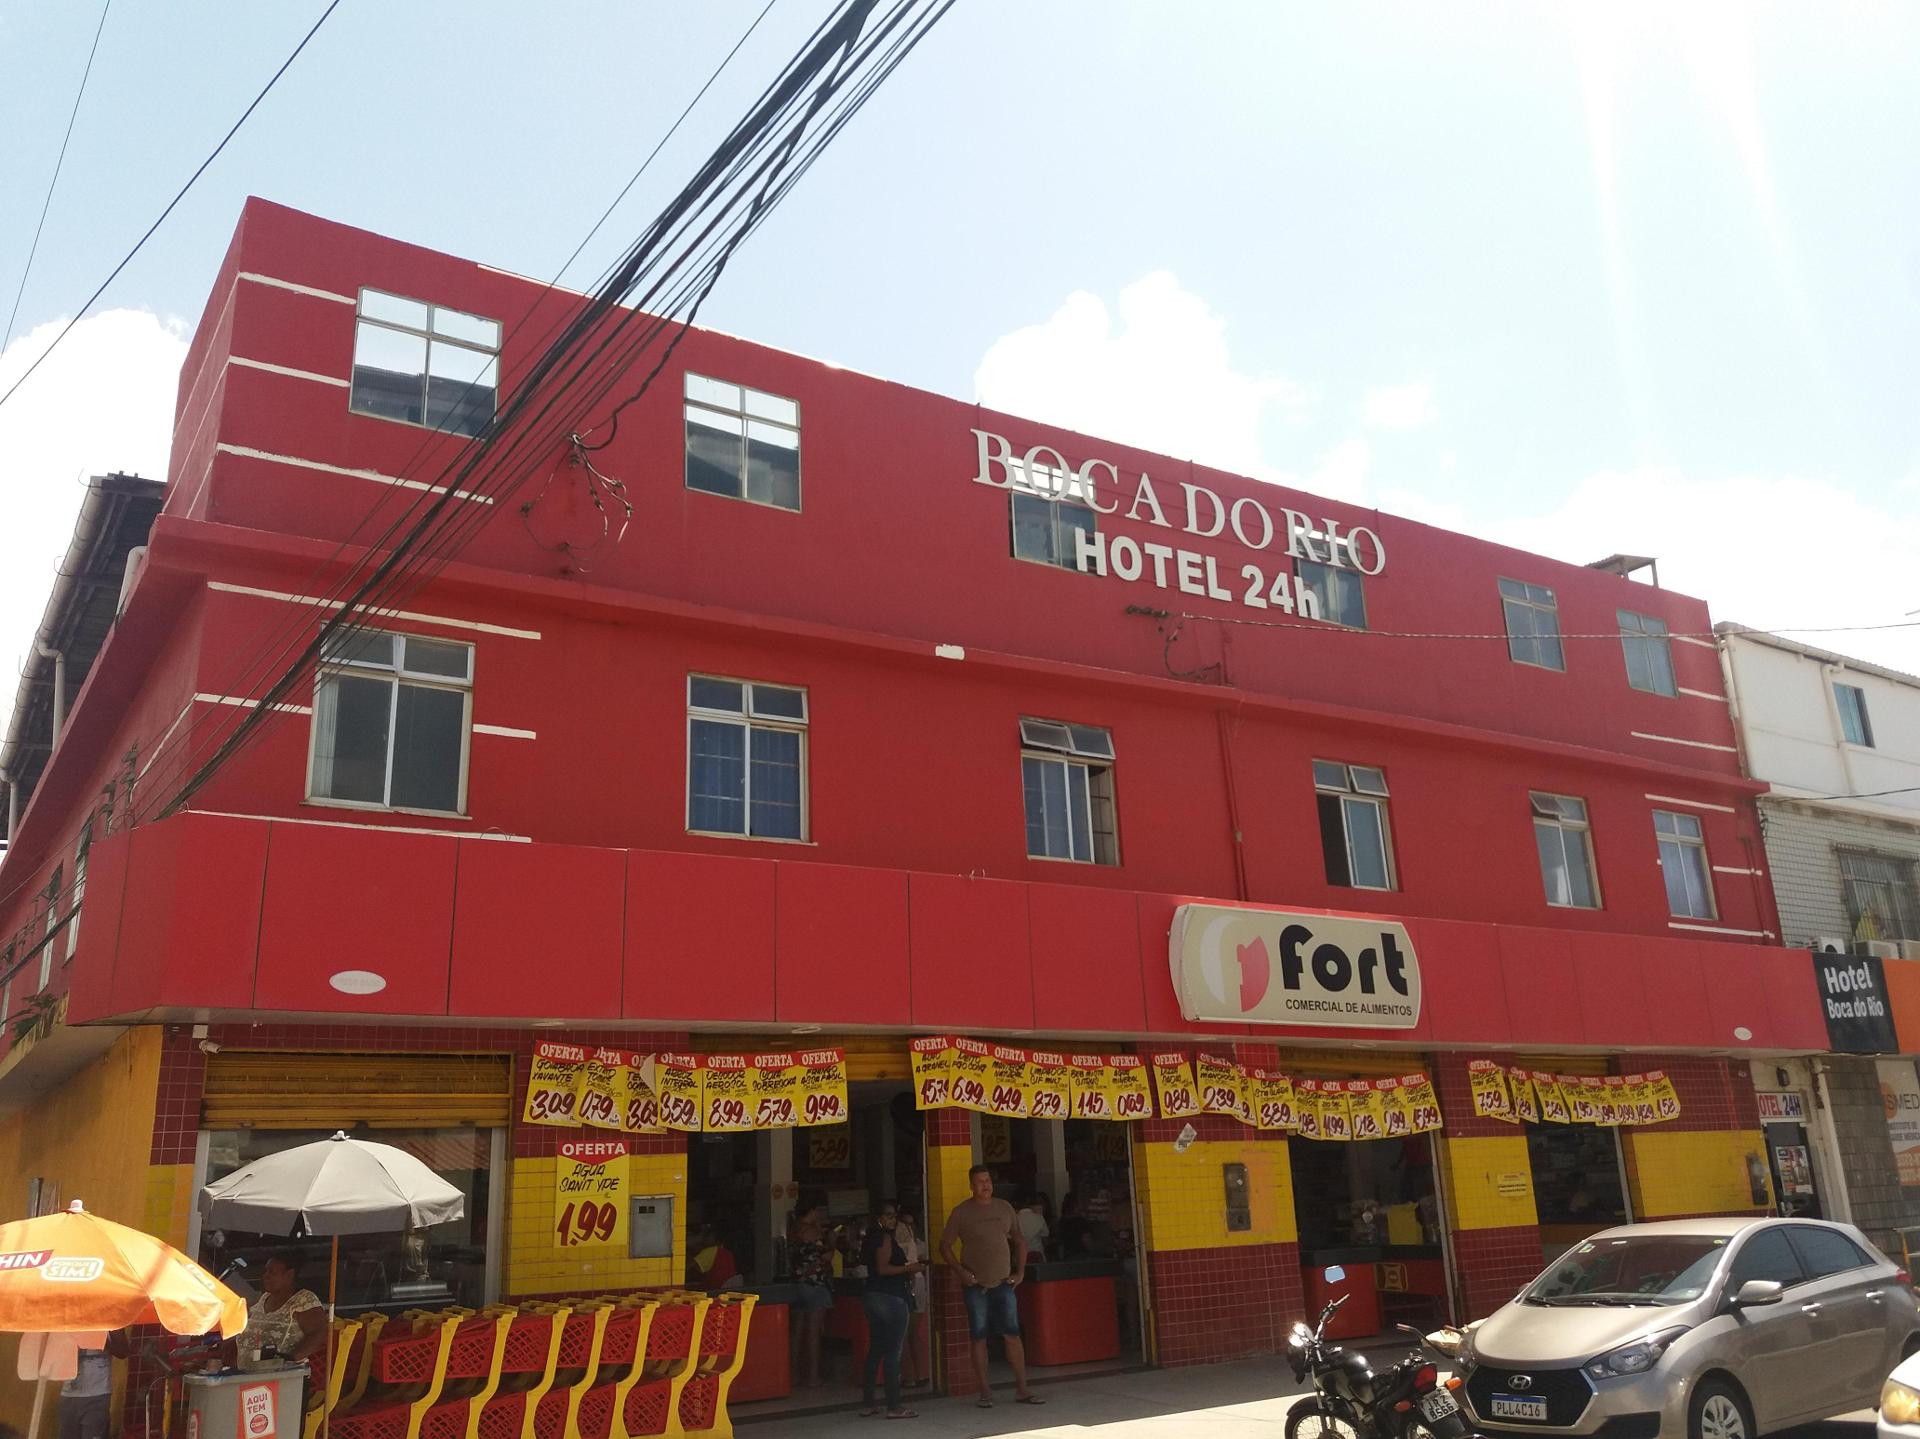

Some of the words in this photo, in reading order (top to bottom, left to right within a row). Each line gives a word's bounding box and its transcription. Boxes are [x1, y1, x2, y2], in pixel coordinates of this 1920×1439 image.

[1075, 526, 1232, 602] HOTEL
[1240, 563, 1319, 621] 24h
[1279, 925, 1409, 996] fort
[1823, 961, 1873, 994] Hotel
[1286, 999, 1343, 1012] COMERCIAL
[1345, 1001, 1359, 1013] DE
[1360, 1002, 1413, 1016] ALIMENTOS
[1826, 998, 1854, 1019] Boca
[1853, 996, 1867, 1017] do
[1866, 995, 1884, 1017] Rio
[540, 1044, 584, 1061] OFERTA
[914, 1037, 948, 1051] OFERTA
[955, 1038, 988, 1055] OFERTA
[708, 1055, 746, 1068] OFERTA
[754, 1054, 793, 1067] OFERTA
[802, 1051, 839, 1066] OFERTA
[994, 1046, 1025, 1061] OFERTA
[1032, 1052, 1064, 1066] OFERTA
[1072, 1055, 1103, 1066] OFERTA
[1110, 1056, 1140, 1066] OFERTA
[1154, 1053, 1183, 1065] OFERTA
[952, 1076, 984, 1105] 6.99
[530, 1089, 575, 1120] 3.09
[709, 1098, 744, 1128] 8.99
[755, 1098, 792, 1127] 5.79
[804, 1094, 839, 1124] 9.99
[562, 1143, 625, 1156] OFERTA
[572, 1163, 606, 1180] AGUA
[559, 1177, 594, 1192] SANIT
[596, 1177, 620, 1192] YPE
[557, 1200, 617, 1246] 1.99
[246, 1393, 268, 1406] AQUI
[247, 1403, 266, 1415] TEM
[1430, 1403, 1455, 1420] 8566
